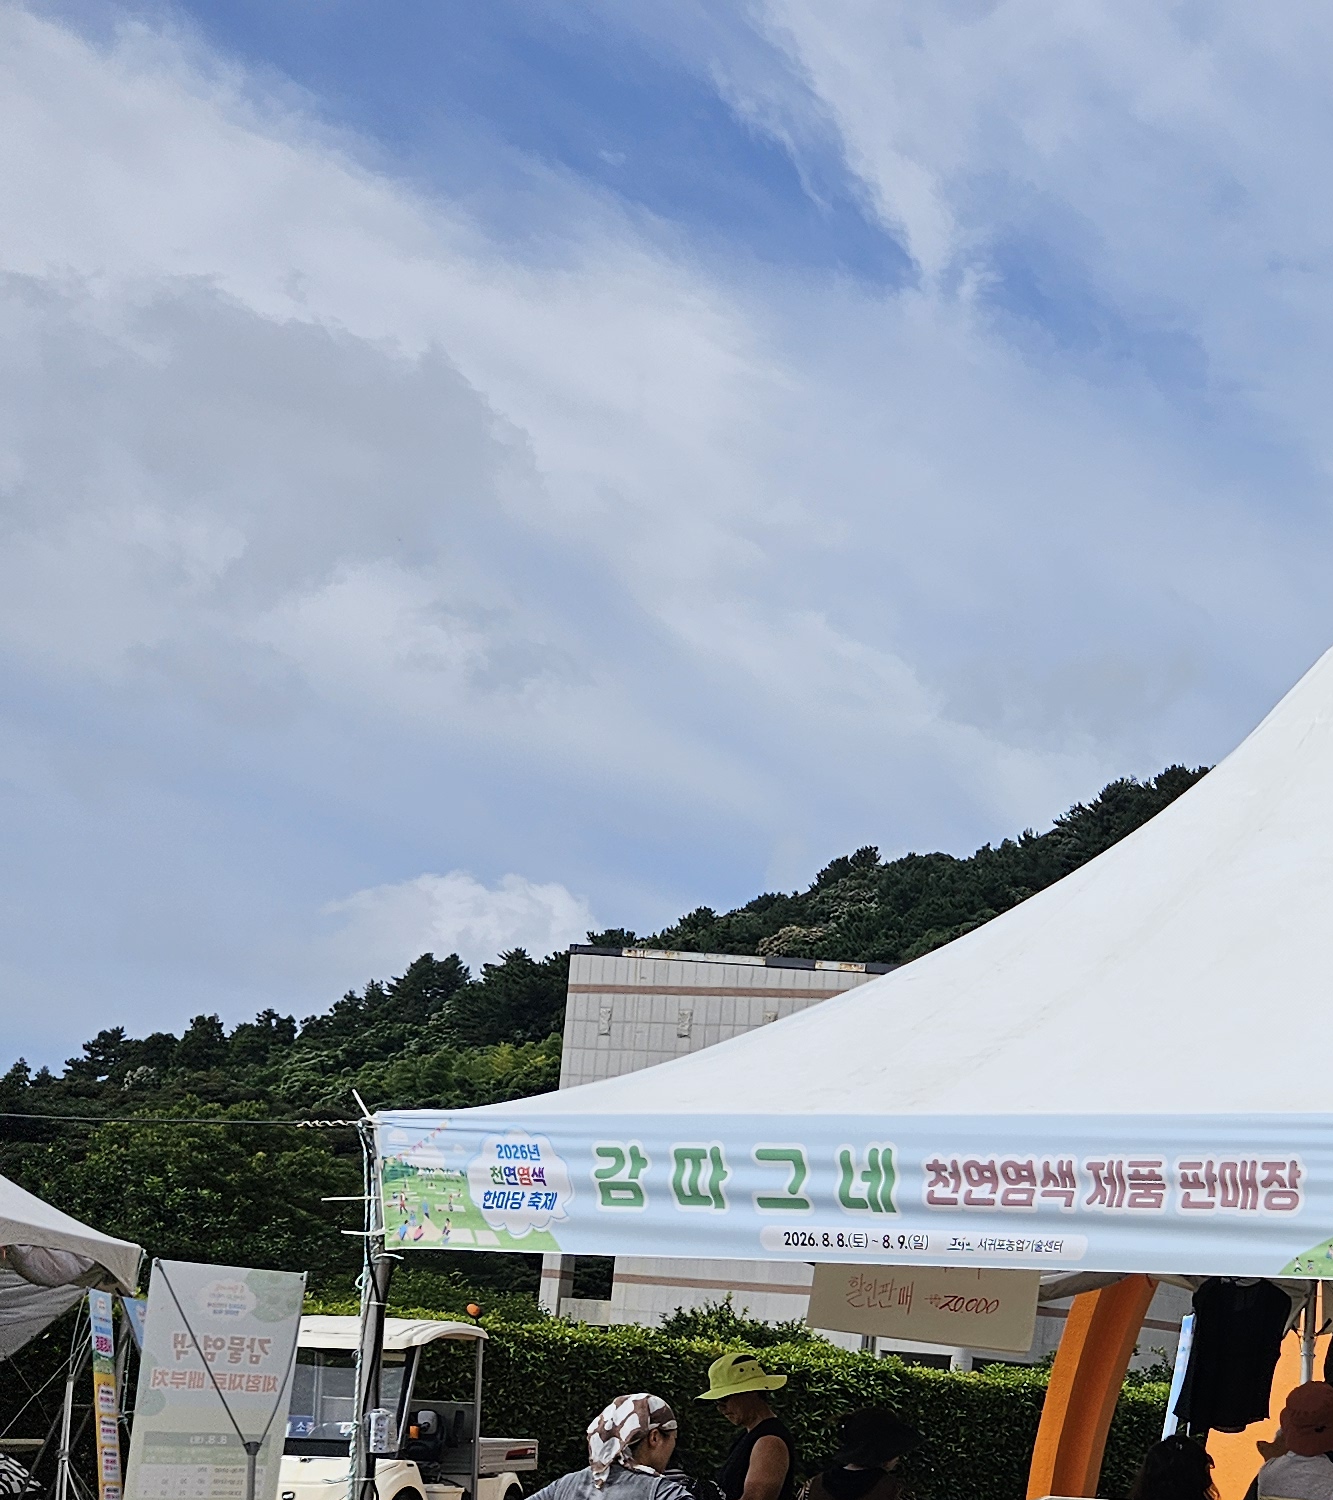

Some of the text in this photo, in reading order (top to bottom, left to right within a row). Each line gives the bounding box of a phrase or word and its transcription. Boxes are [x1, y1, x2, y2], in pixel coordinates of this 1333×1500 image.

[496, 1143, 541, 1161] 2026년
[489, 1165, 547, 1187] 천연염색
[925, 1158, 1076, 1208] 천연염색
[1085, 1159, 1166, 1209] 제품
[1178, 1159, 1301, 1211] 판매장
[482, 1190, 558, 1211] 한마당 축제
[783, 1231, 819, 1247] 2026.
[821, 1232, 834, 1248] 8.
[977, 1237, 1064, 1254] 서귀포농업기술센터
[845, 1273, 915, 1315] 할인판매
